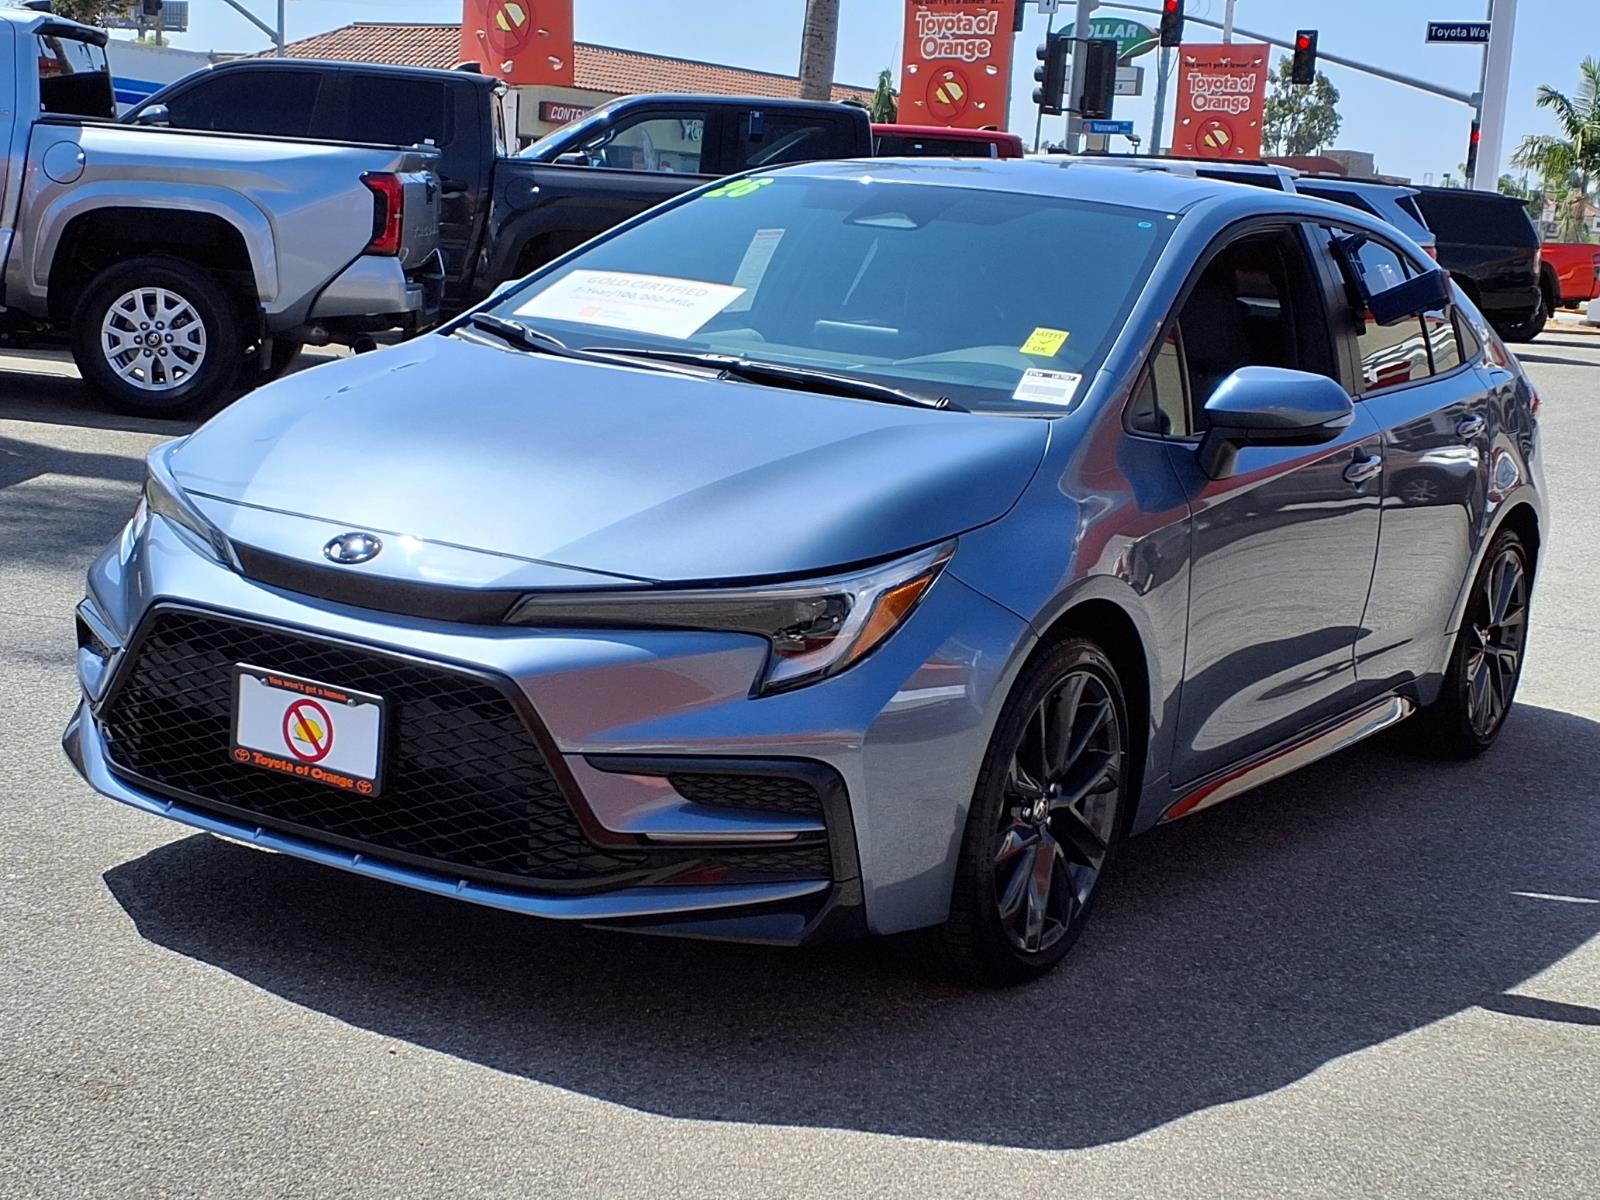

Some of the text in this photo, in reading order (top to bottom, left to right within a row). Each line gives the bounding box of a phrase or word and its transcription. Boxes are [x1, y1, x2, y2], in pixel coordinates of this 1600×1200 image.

[916, 11, 998, 37] Toyota of
[1088, 24, 1138, 38] OLLAR
[1431, 26, 1490, 39] Toyota Way
[921, 36, 991, 62] Orange
[1187, 73, 1256, 94] Toyota of
[1192, 92, 1250, 115] Orange
[586, 276, 710, 297] GOLD CERTIFIED
[268, 675, 283, 686] You
[283, 680, 305, 691] won't
[305, 685, 317, 694] get
[252, 752, 354, 788] Toyota of Orange
